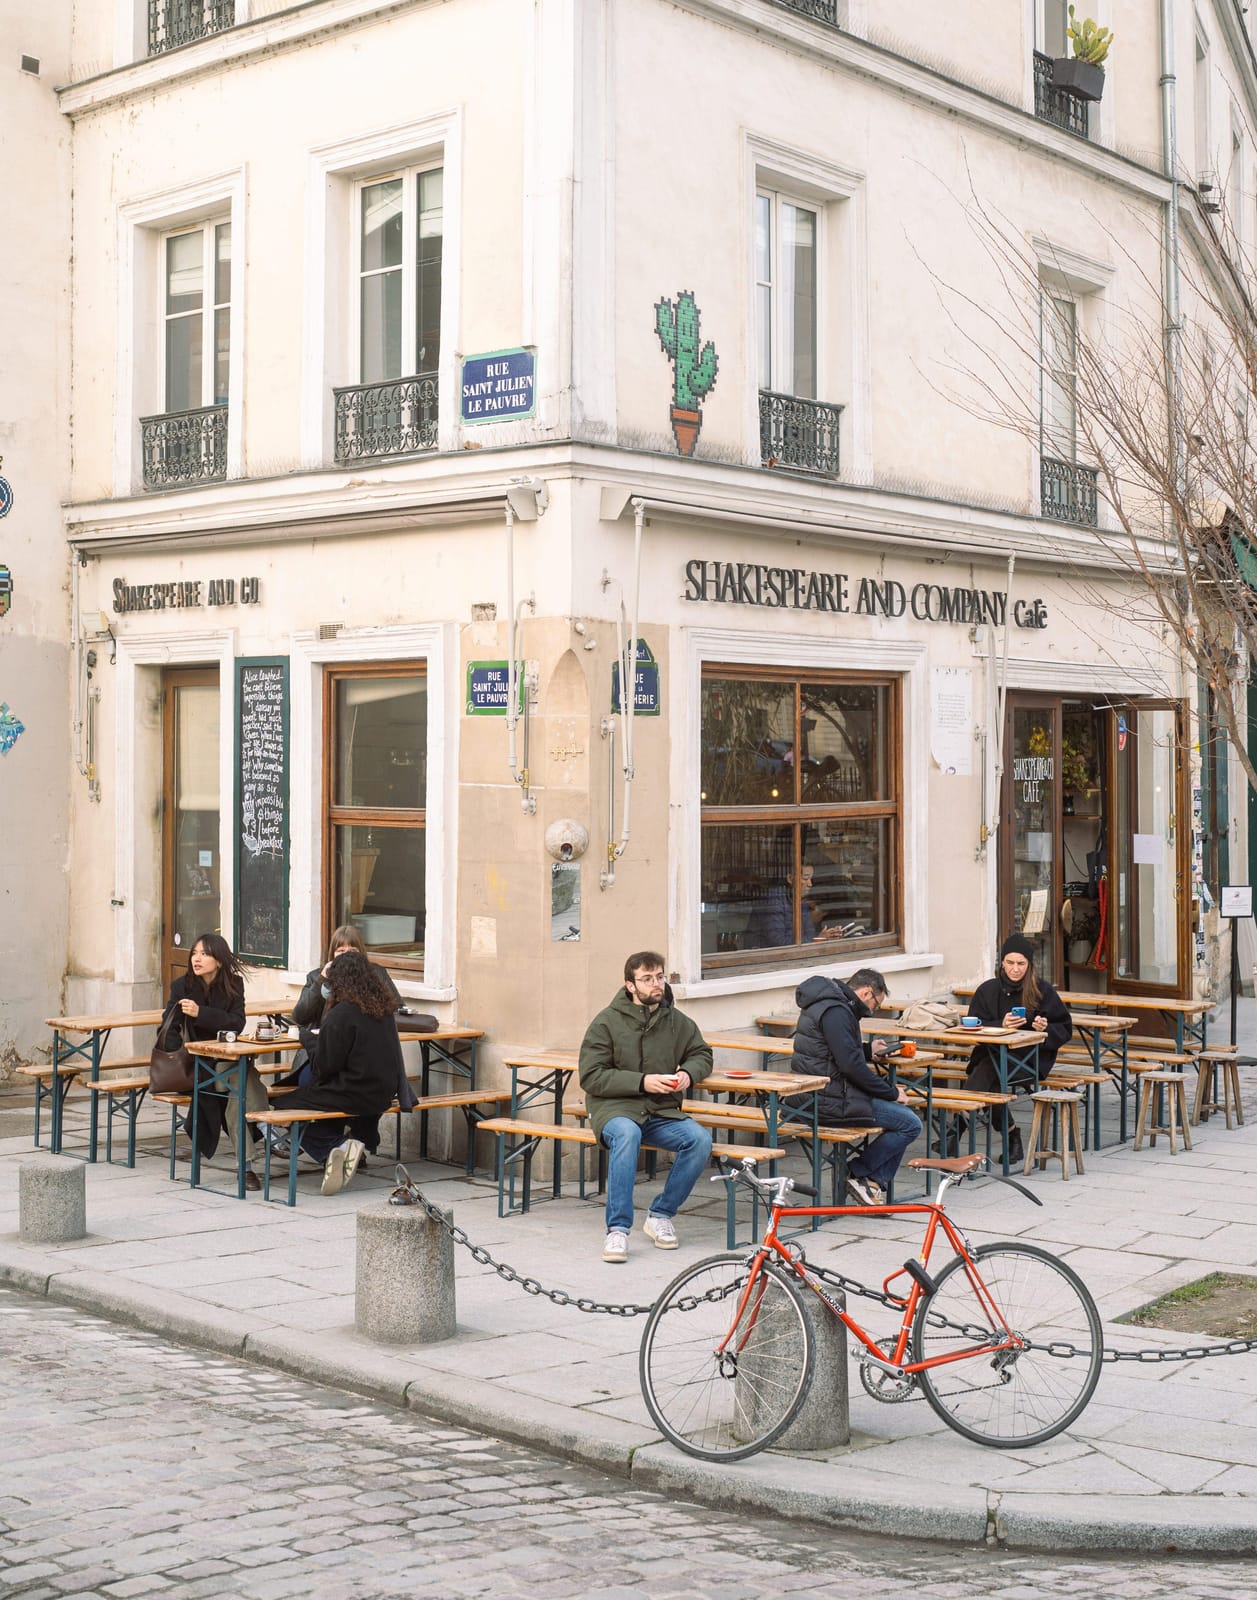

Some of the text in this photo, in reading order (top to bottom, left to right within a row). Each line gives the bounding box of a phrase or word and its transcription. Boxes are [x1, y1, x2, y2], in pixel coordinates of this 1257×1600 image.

[487, 362, 509, 377] RUE
[463, 375, 534, 397] SAINT JULIEN
[468, 393, 526, 413] LE PAUVRE
[112, 577, 260, 613] SHAKESPEARE AND CO
[686, 560, 1048, 629] SHAKESPEARE AND COMPANY Café
[487, 671, 502, 681] RUE
[473, 683, 515, 692] SAINT-JULI
[477, 694, 509, 703] LE PAUVR
